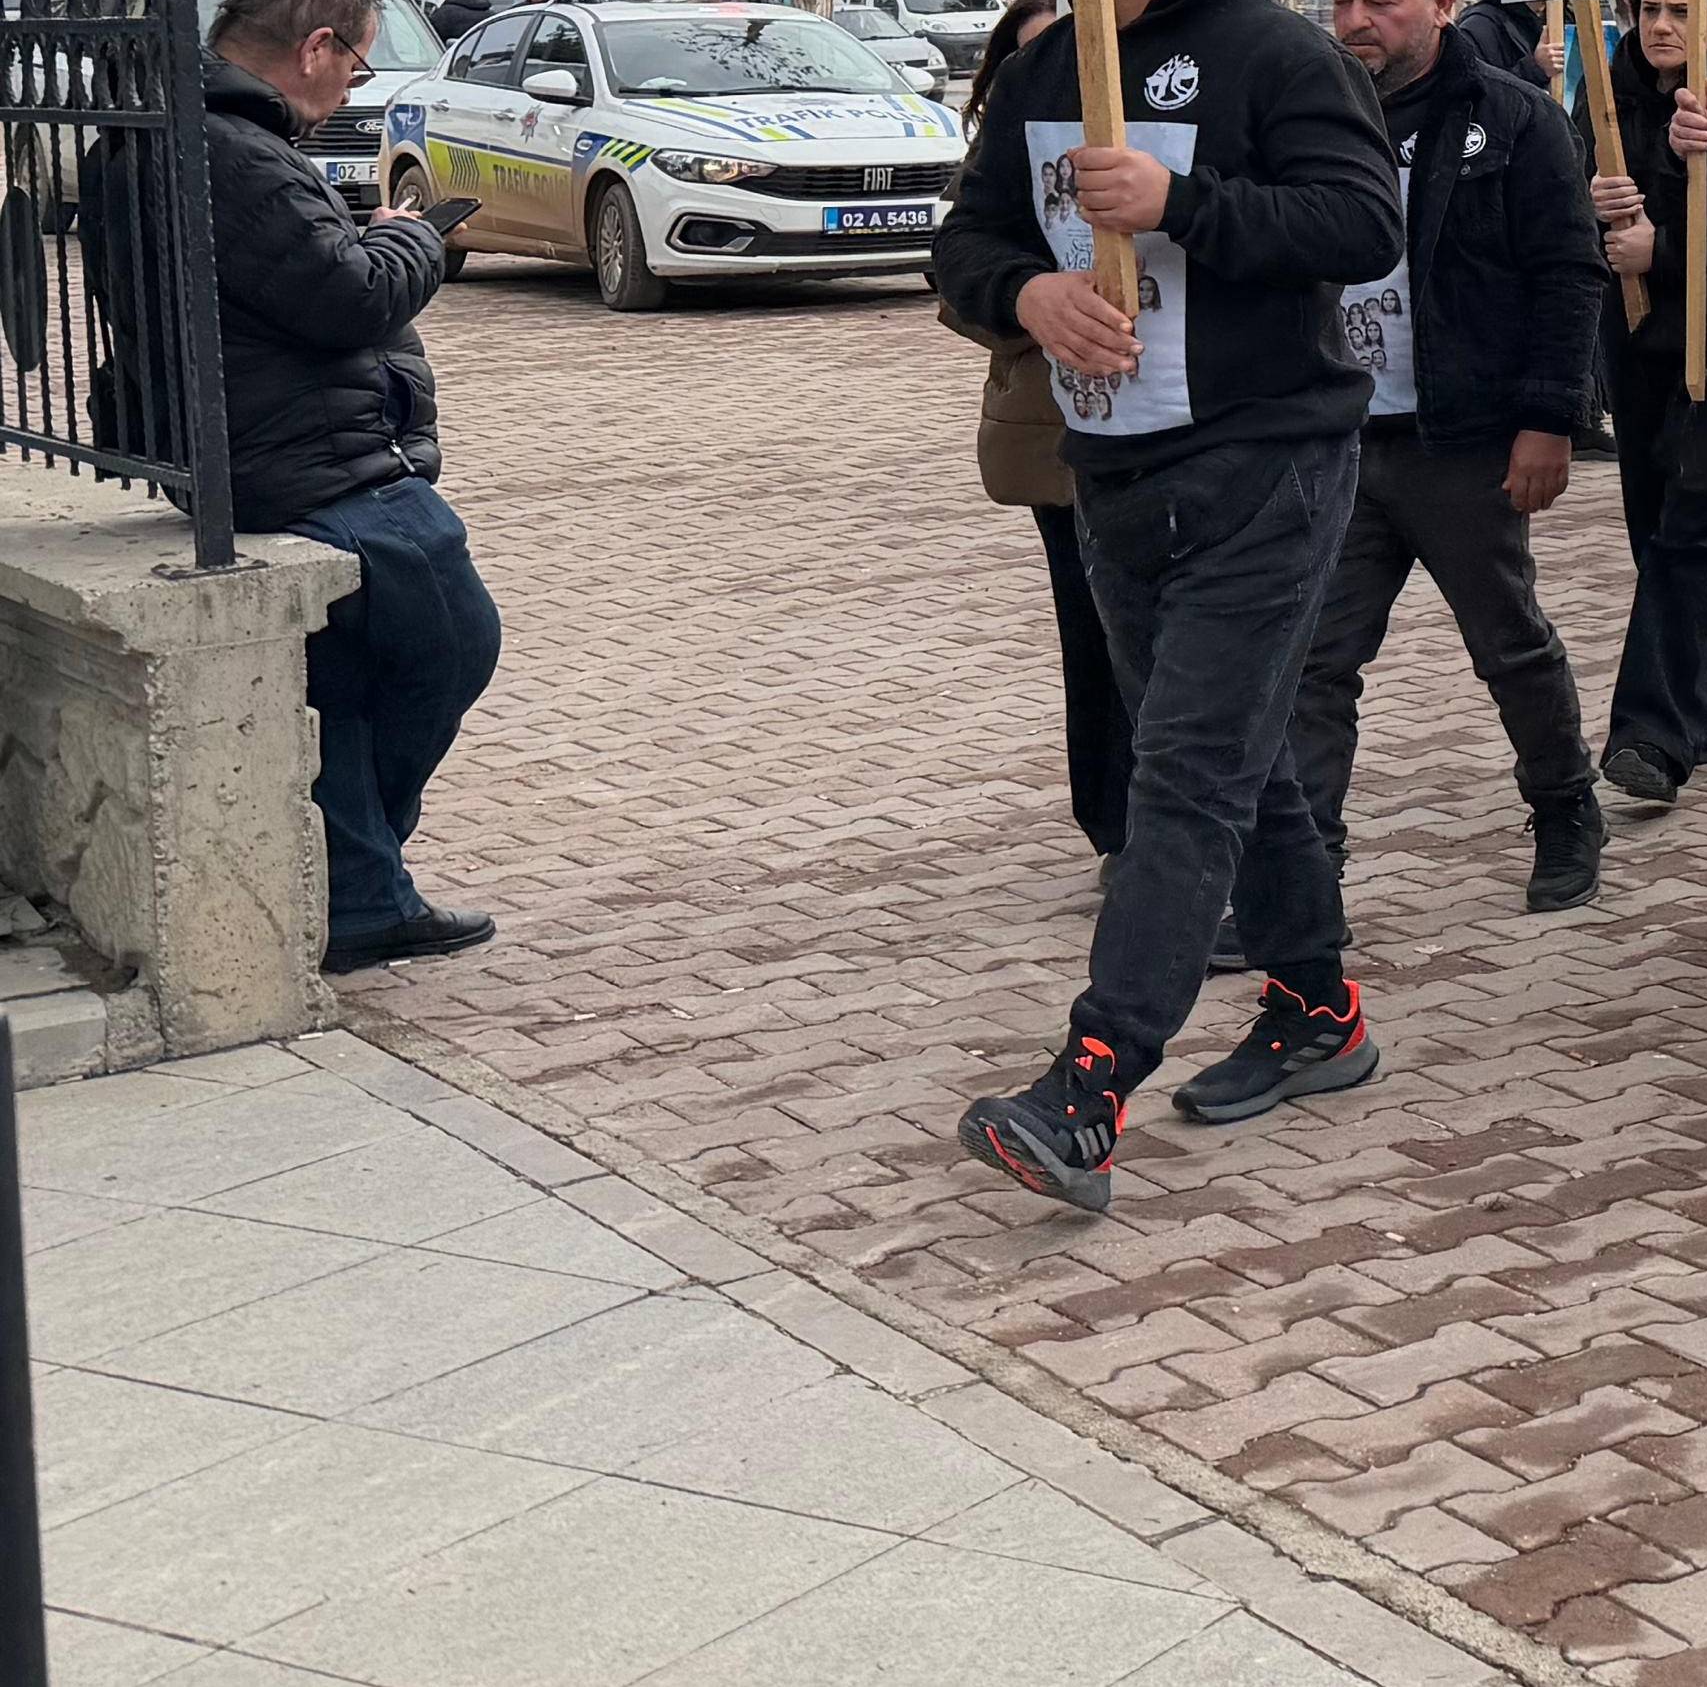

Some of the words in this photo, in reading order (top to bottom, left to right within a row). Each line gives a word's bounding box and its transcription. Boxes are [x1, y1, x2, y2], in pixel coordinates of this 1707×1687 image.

[338, 165, 356, 179] 02
[863, 167, 895, 191] FIAT
[842, 213, 864, 227] 02
[869, 213, 882, 226] A
[887, 211, 928, 226] 5436
